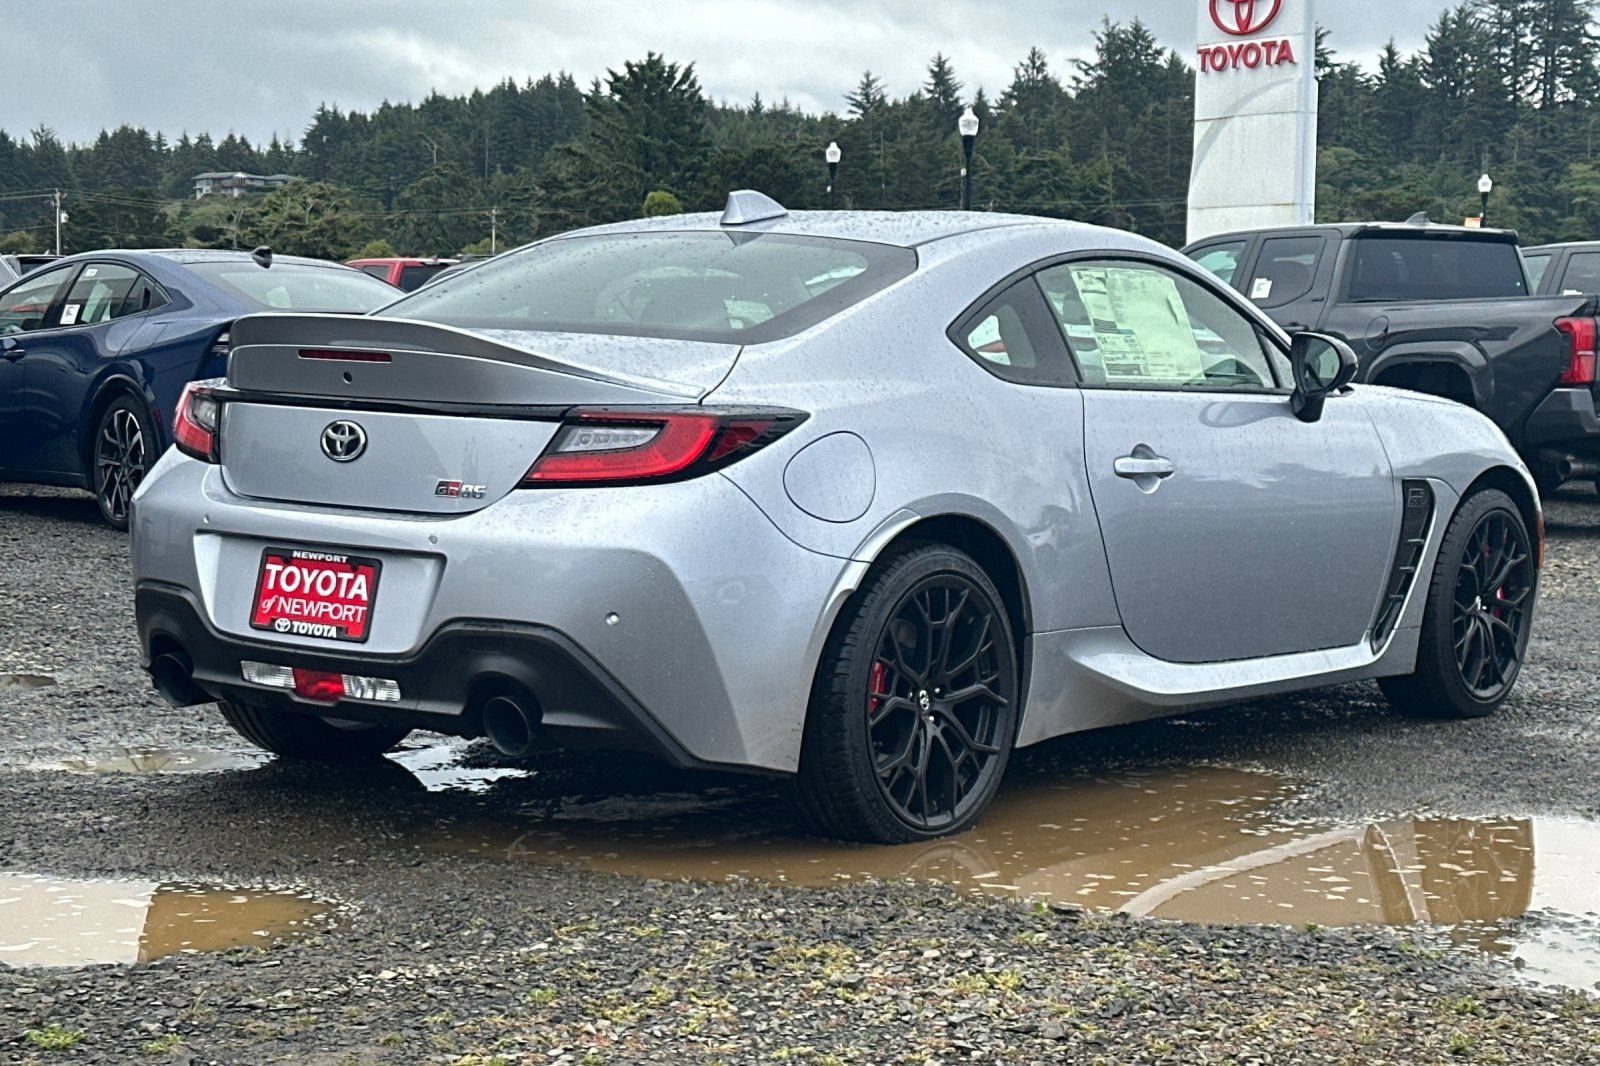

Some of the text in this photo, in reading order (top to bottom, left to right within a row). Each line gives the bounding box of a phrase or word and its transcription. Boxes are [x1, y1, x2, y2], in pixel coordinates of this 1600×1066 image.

[1197, 40, 1295, 72] TOYOTA
[292, 550, 348, 563] NEWPORT
[265, 563, 368, 601] TOYOTA
[261, 595, 367, 623] of NEWPORT
[292, 621, 337, 638] TOYOTA
